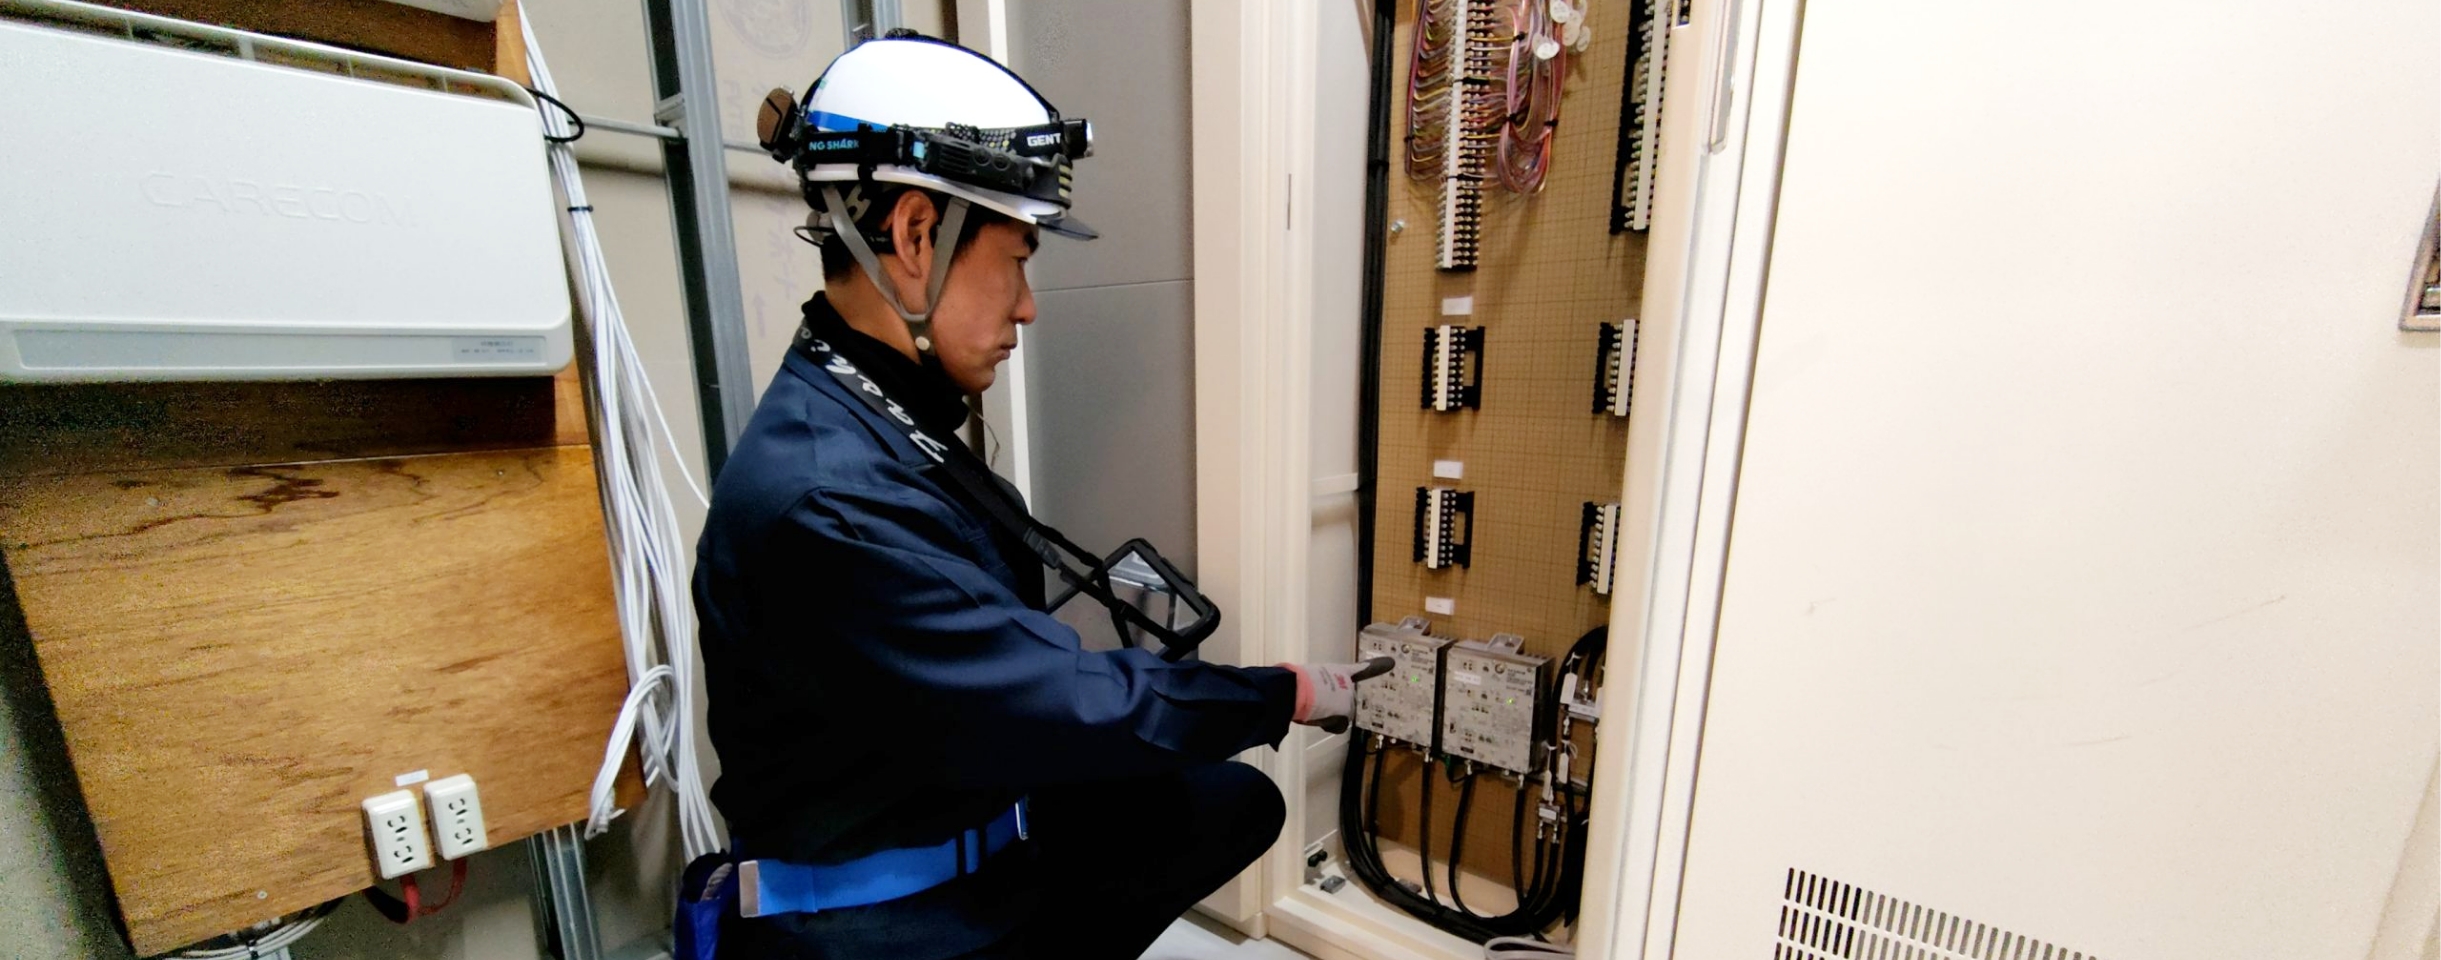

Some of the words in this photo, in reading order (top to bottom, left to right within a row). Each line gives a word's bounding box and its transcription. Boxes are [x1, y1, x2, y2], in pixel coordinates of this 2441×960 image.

[826, 138, 860, 150] SHARK
[1026, 132, 1061, 147] GENT
[138, 170, 419, 228] CARECOM
